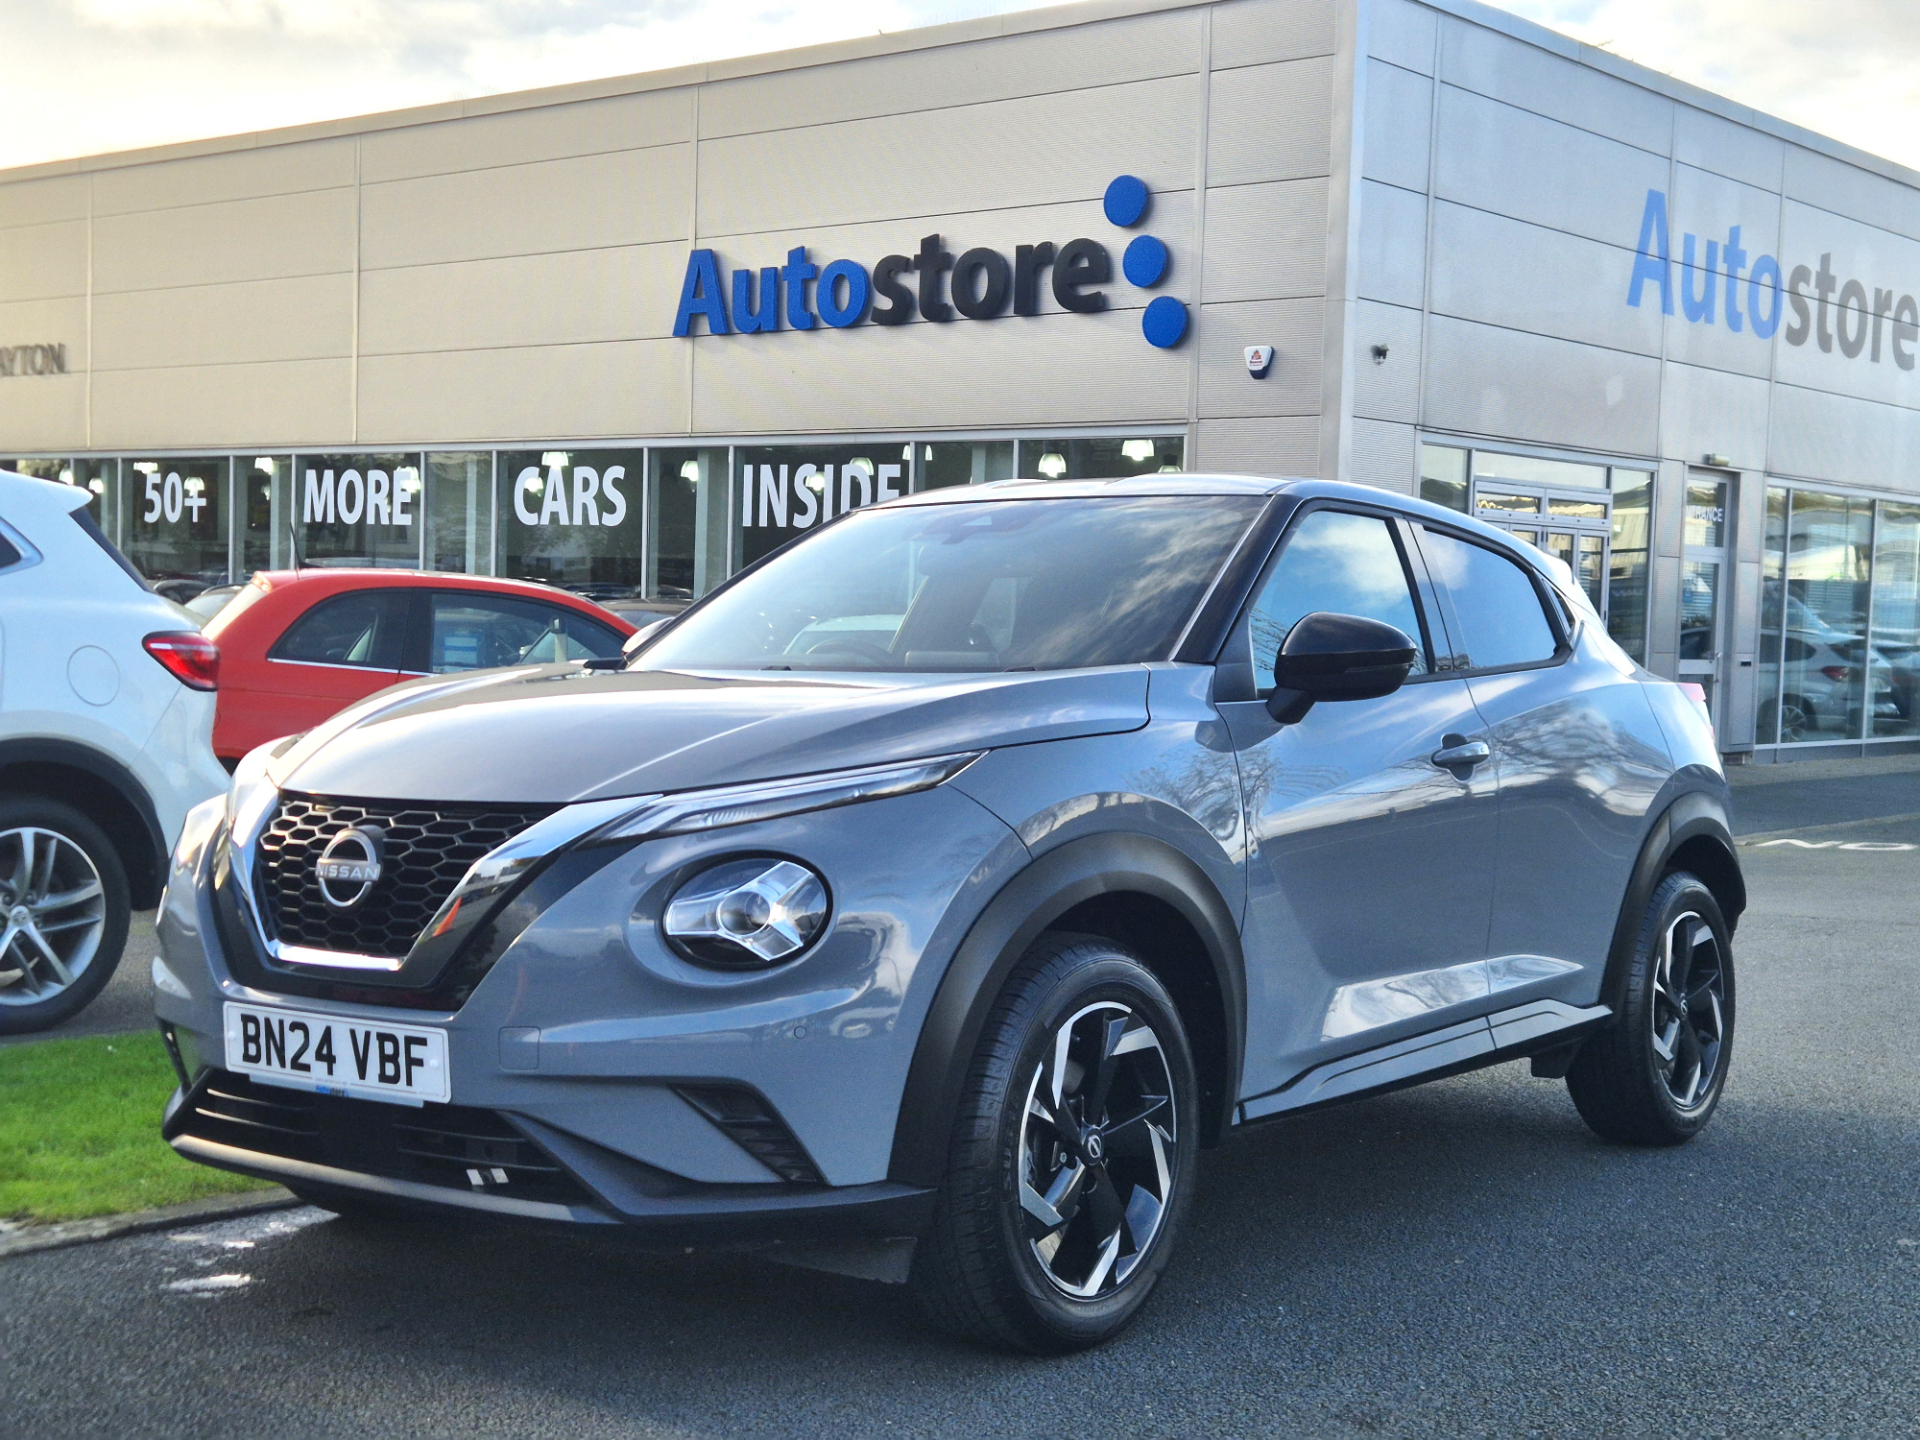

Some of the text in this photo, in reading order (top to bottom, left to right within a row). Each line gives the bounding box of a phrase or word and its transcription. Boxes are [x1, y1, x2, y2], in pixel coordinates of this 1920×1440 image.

[672, 233, 1110, 337] Autostore
[1626, 188, 1919, 371] Autostore
[144, 472, 207, 523] 50+
[303, 469, 413, 526] MORE
[514, 465, 627, 527] CARS
[315, 862, 378, 880] NISSAN
[240, 1013, 428, 1087] BN24 VBF
